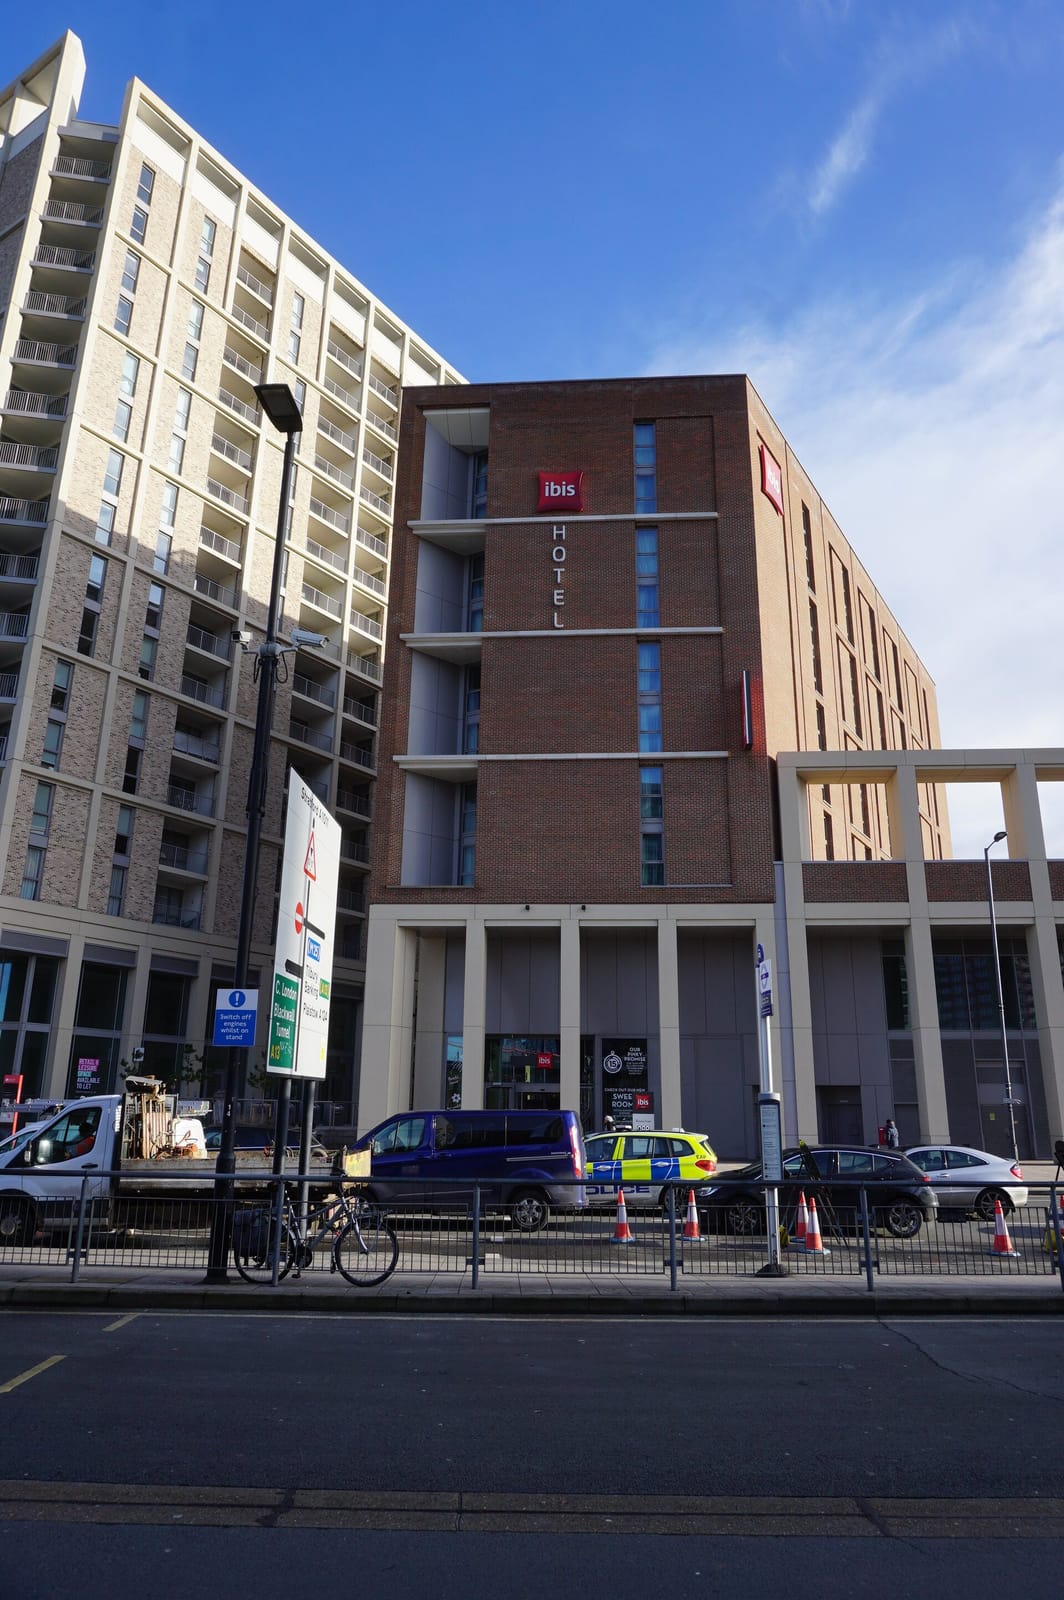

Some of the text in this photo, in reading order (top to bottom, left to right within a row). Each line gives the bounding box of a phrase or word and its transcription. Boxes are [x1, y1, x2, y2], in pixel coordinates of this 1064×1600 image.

[545, 481, 576, 497] ibis
[552, 525, 566, 628] HOTEL
[301, 787, 319, 817] Stratford
[281, 982, 297, 1001] London
[305, 980, 318, 1001] Barking
[273, 1002, 295, 1022] Blackwall
[303, 1002, 318, 1018] Plaistow
[276, 1022, 290, 1039] Tunnel
[270, 1044, 281, 1060] A13
[539, 1056, 551, 1064] ibis
[638, 1098, 649, 1106] ibis
[585, 1185, 650, 1195] OLICE
